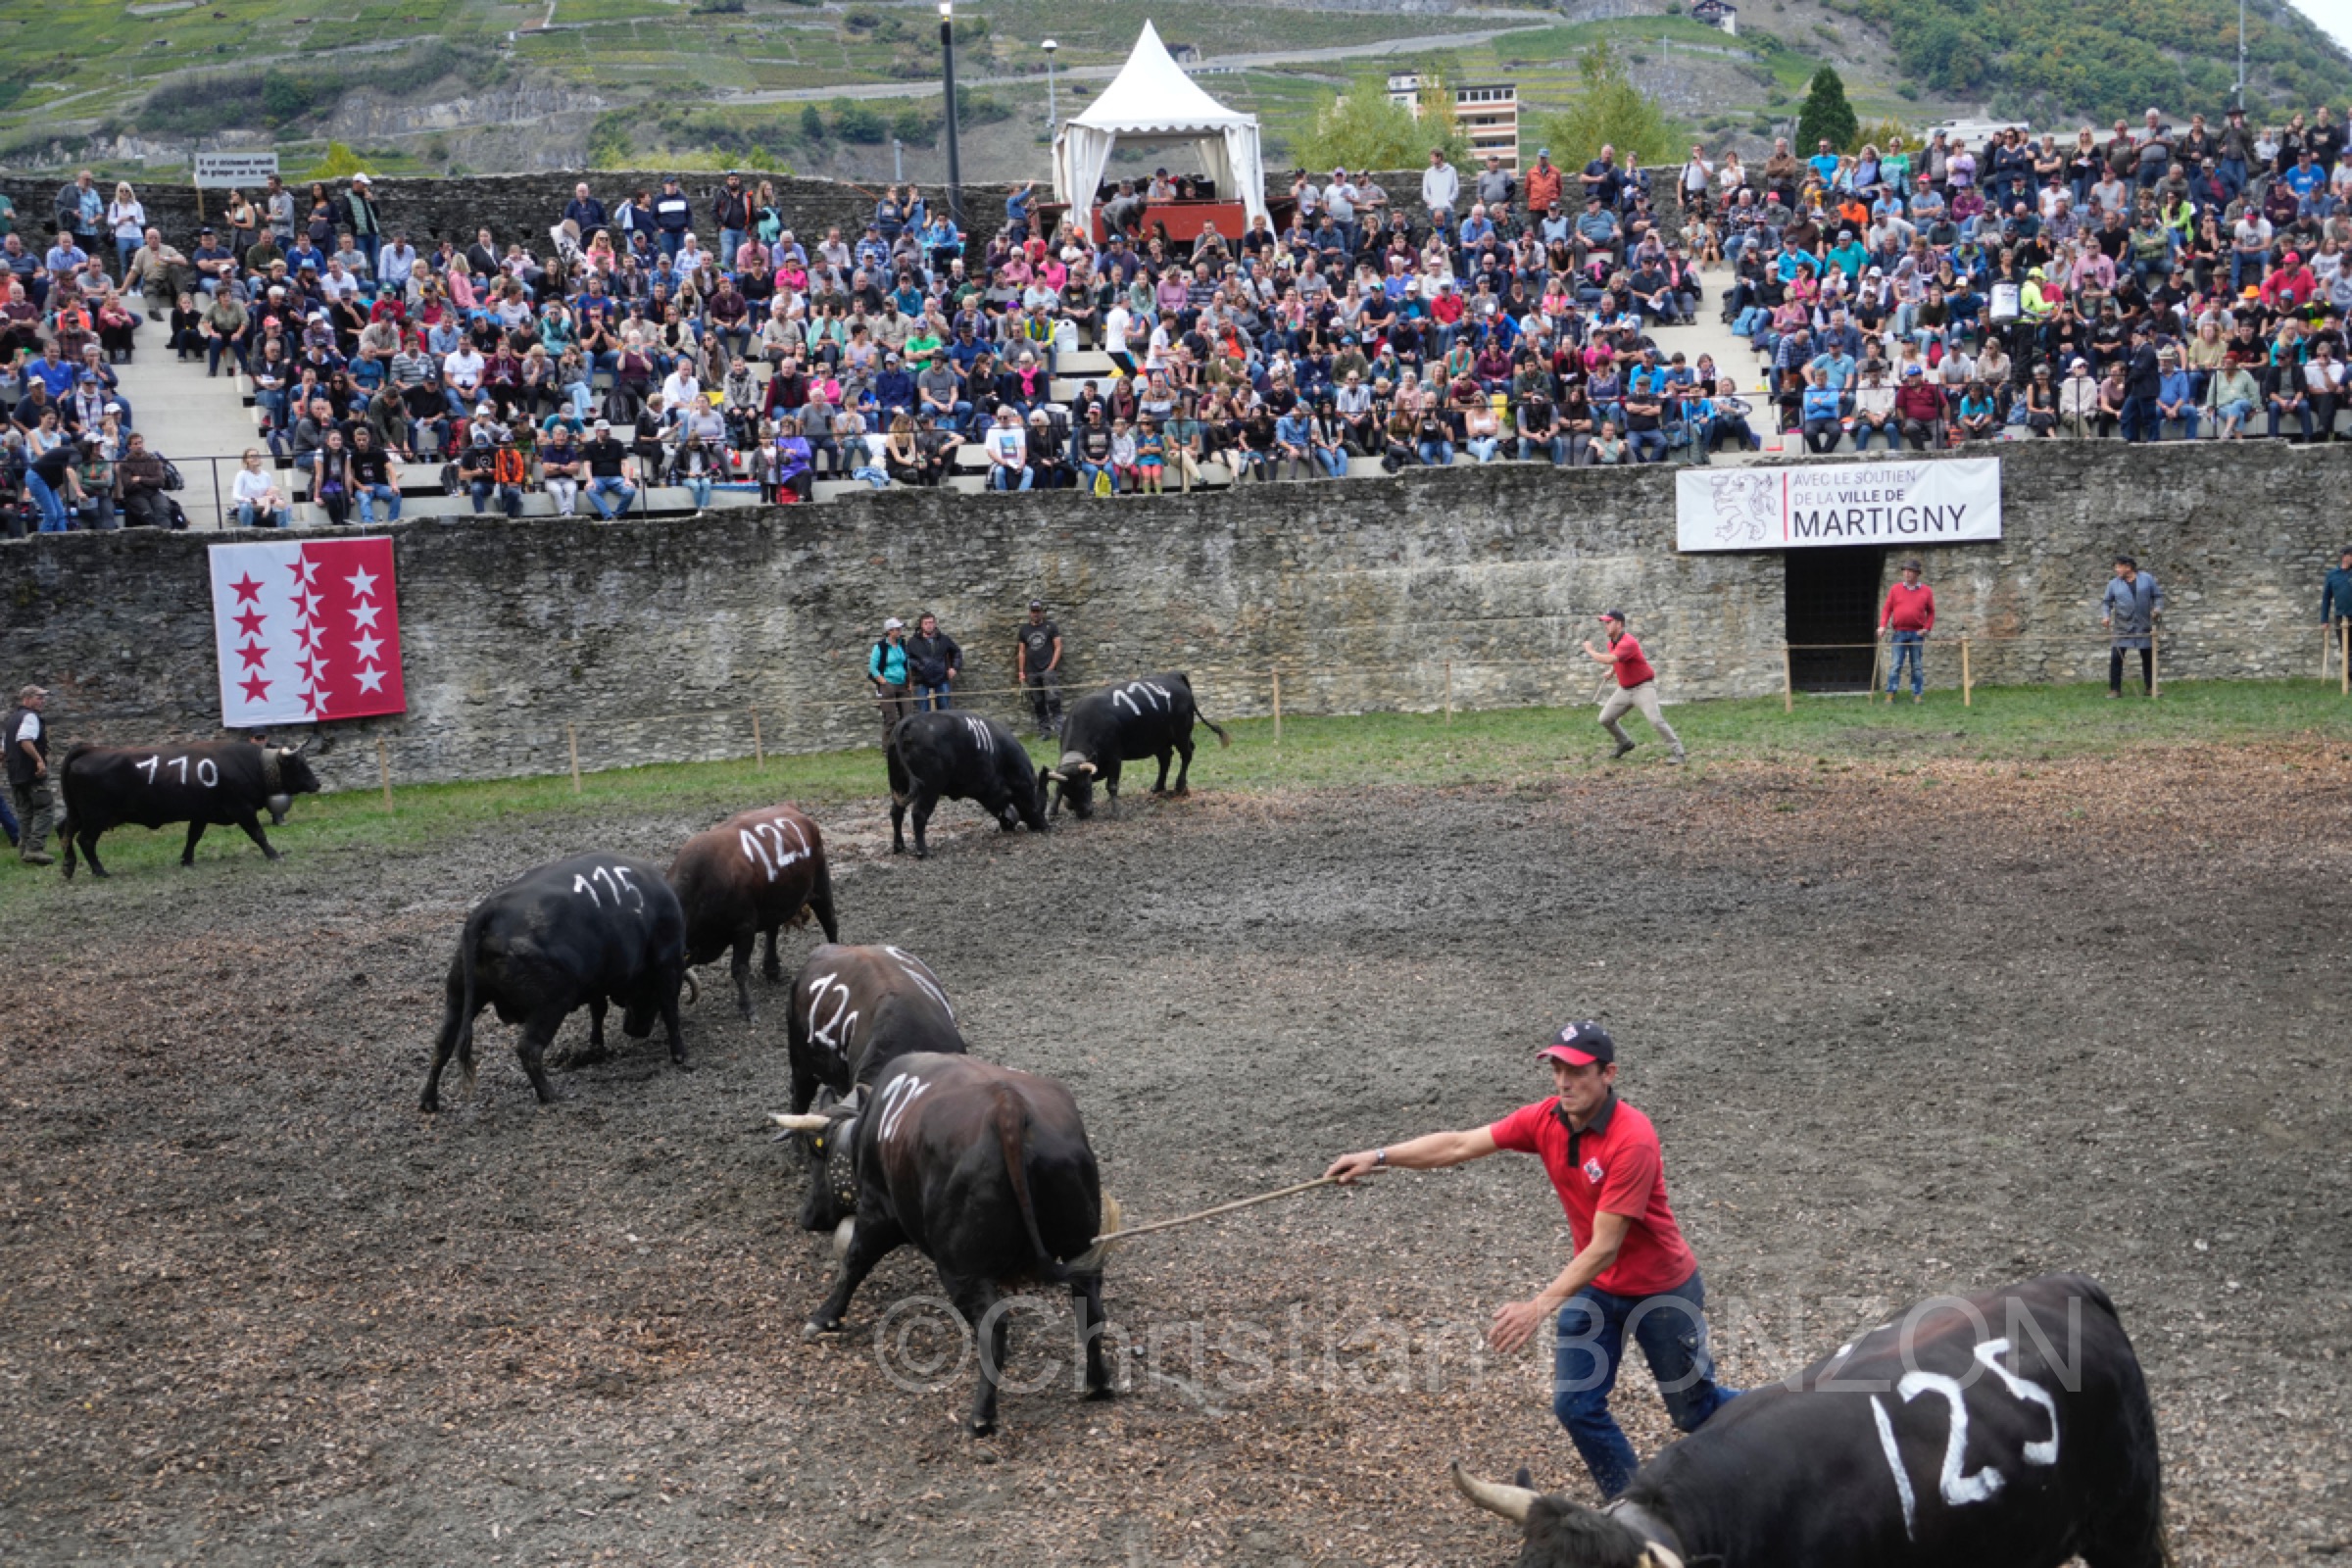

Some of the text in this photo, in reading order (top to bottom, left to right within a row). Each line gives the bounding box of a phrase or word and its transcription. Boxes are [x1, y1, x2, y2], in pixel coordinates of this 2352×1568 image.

[1793, 469, 1917, 486] AVEC LE SOUTIEN
[1794, 489, 1904, 506] DE LA VILLE DE
[1793, 504, 1967, 538] MARTIGNY
[135, 754, 218, 788] 110
[573, 865, 644, 917] 115
[1870, 1338, 2058, 1542] 125
